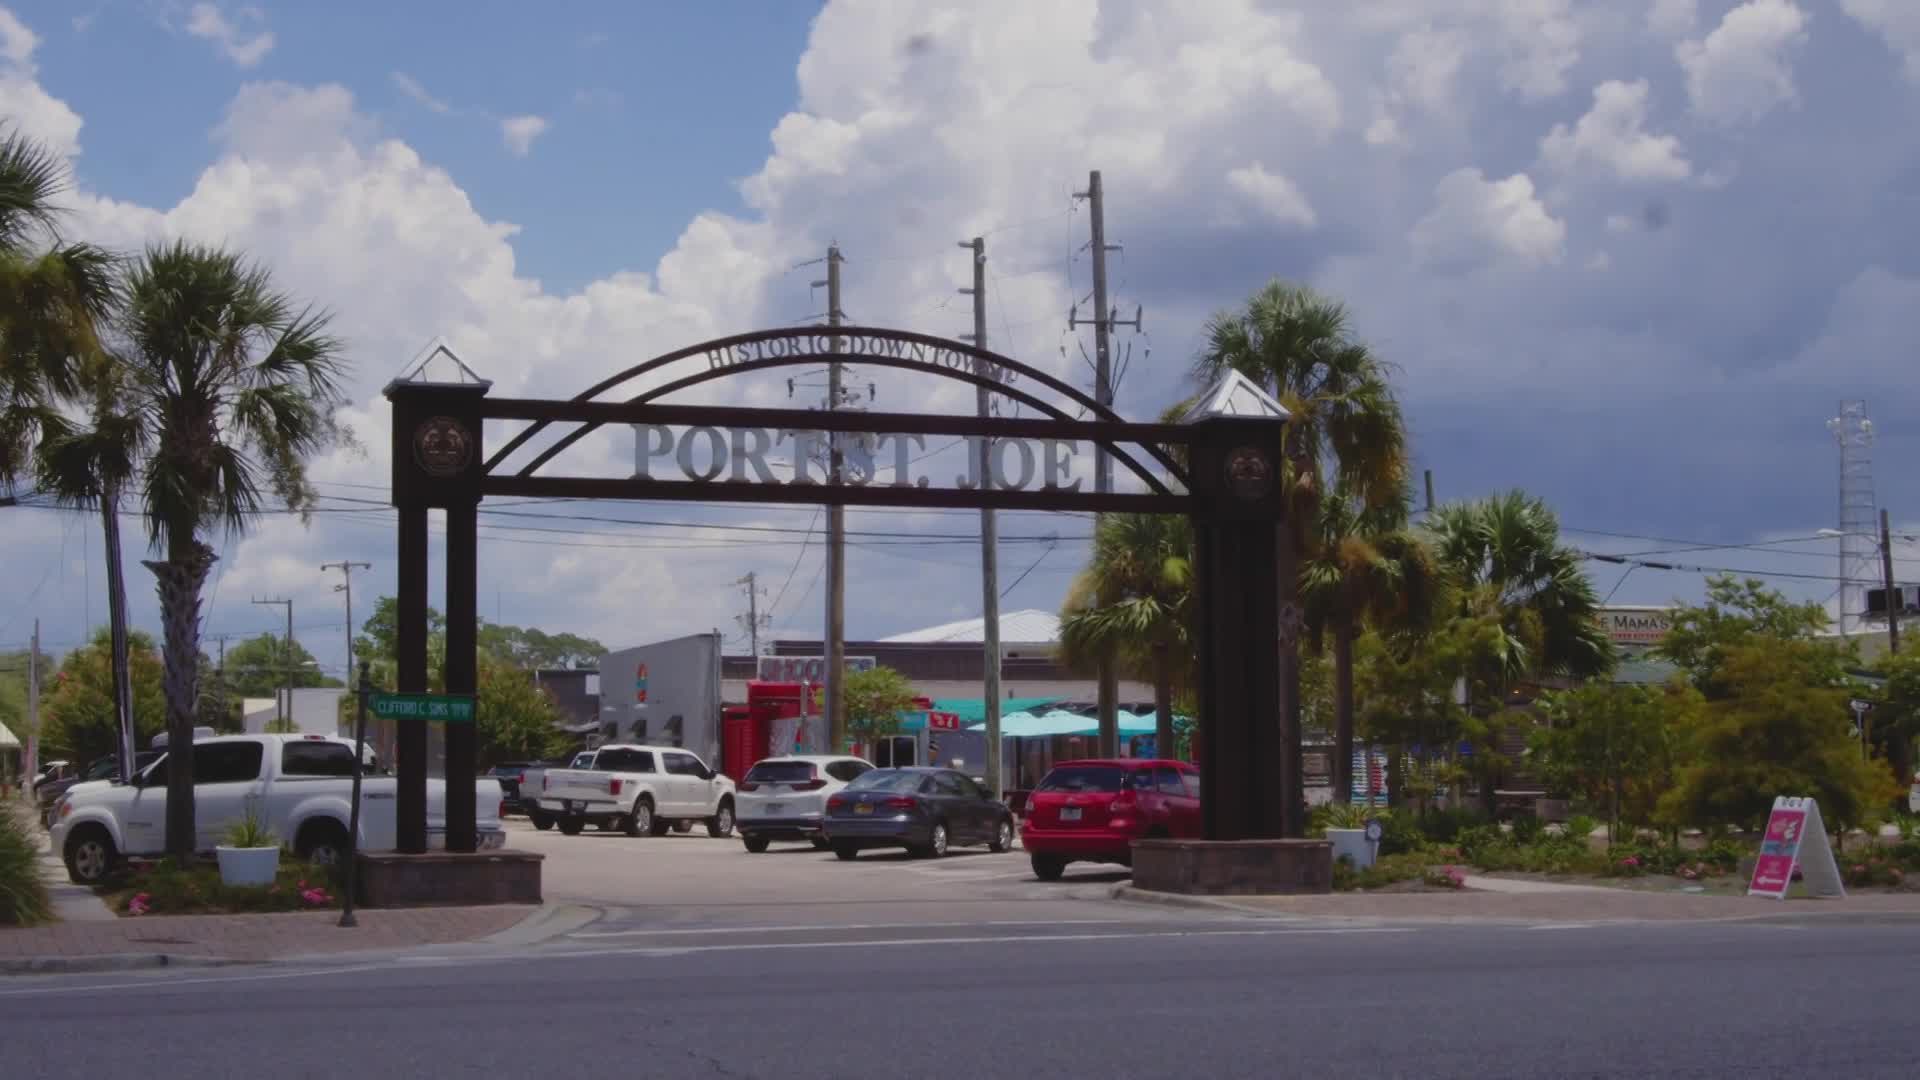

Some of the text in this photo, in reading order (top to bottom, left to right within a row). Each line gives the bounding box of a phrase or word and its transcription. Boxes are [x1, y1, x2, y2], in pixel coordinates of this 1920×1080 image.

[706, 334, 1018, 384] HISTORIC DOWNTOWN
[629, 423, 1081, 493] PORT ST. JOE
[377, 701, 417, 715] CLIFFORD
